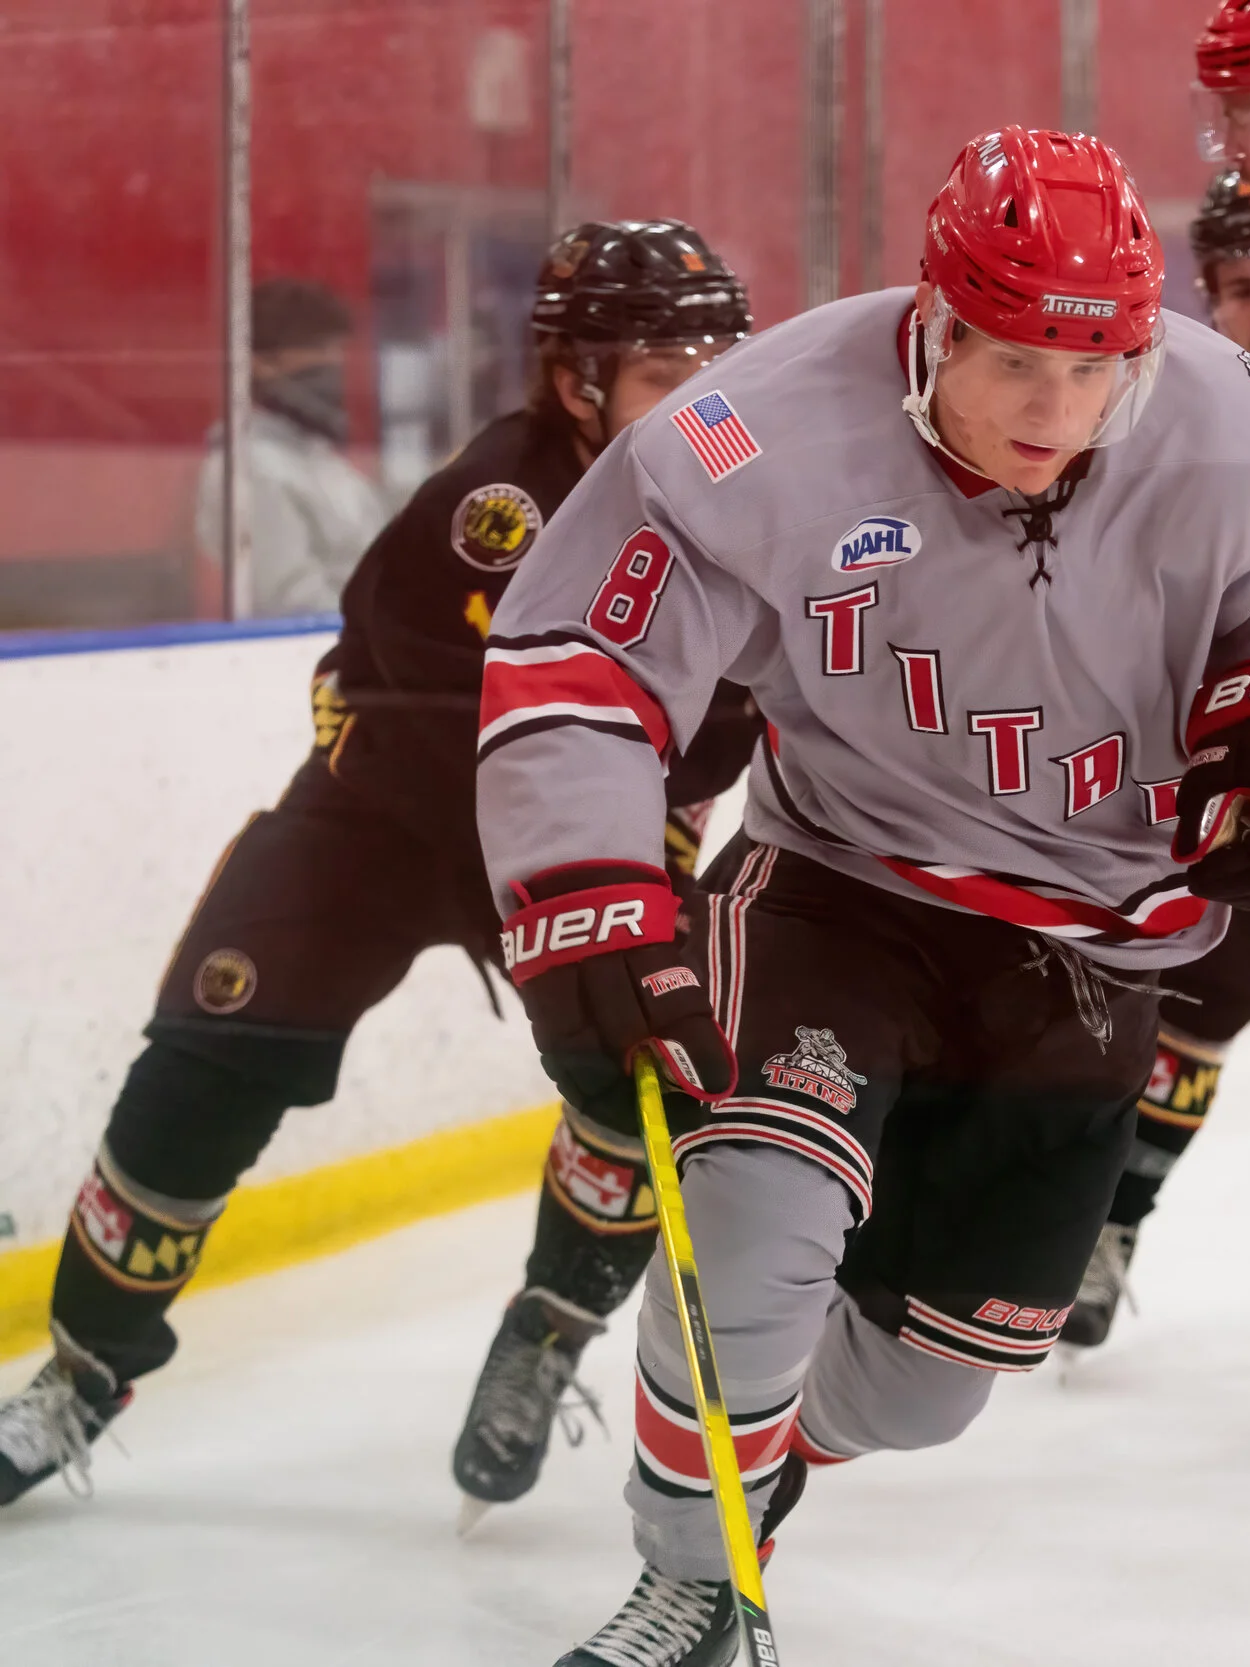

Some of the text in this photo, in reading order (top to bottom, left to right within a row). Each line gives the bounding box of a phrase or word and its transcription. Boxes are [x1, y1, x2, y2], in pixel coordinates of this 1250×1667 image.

[1042, 293, 1117, 318] TITANS
[841, 528, 912, 569] NAHL
[583, 521, 677, 650] 8
[761, 1063, 857, 1115] TITANS
